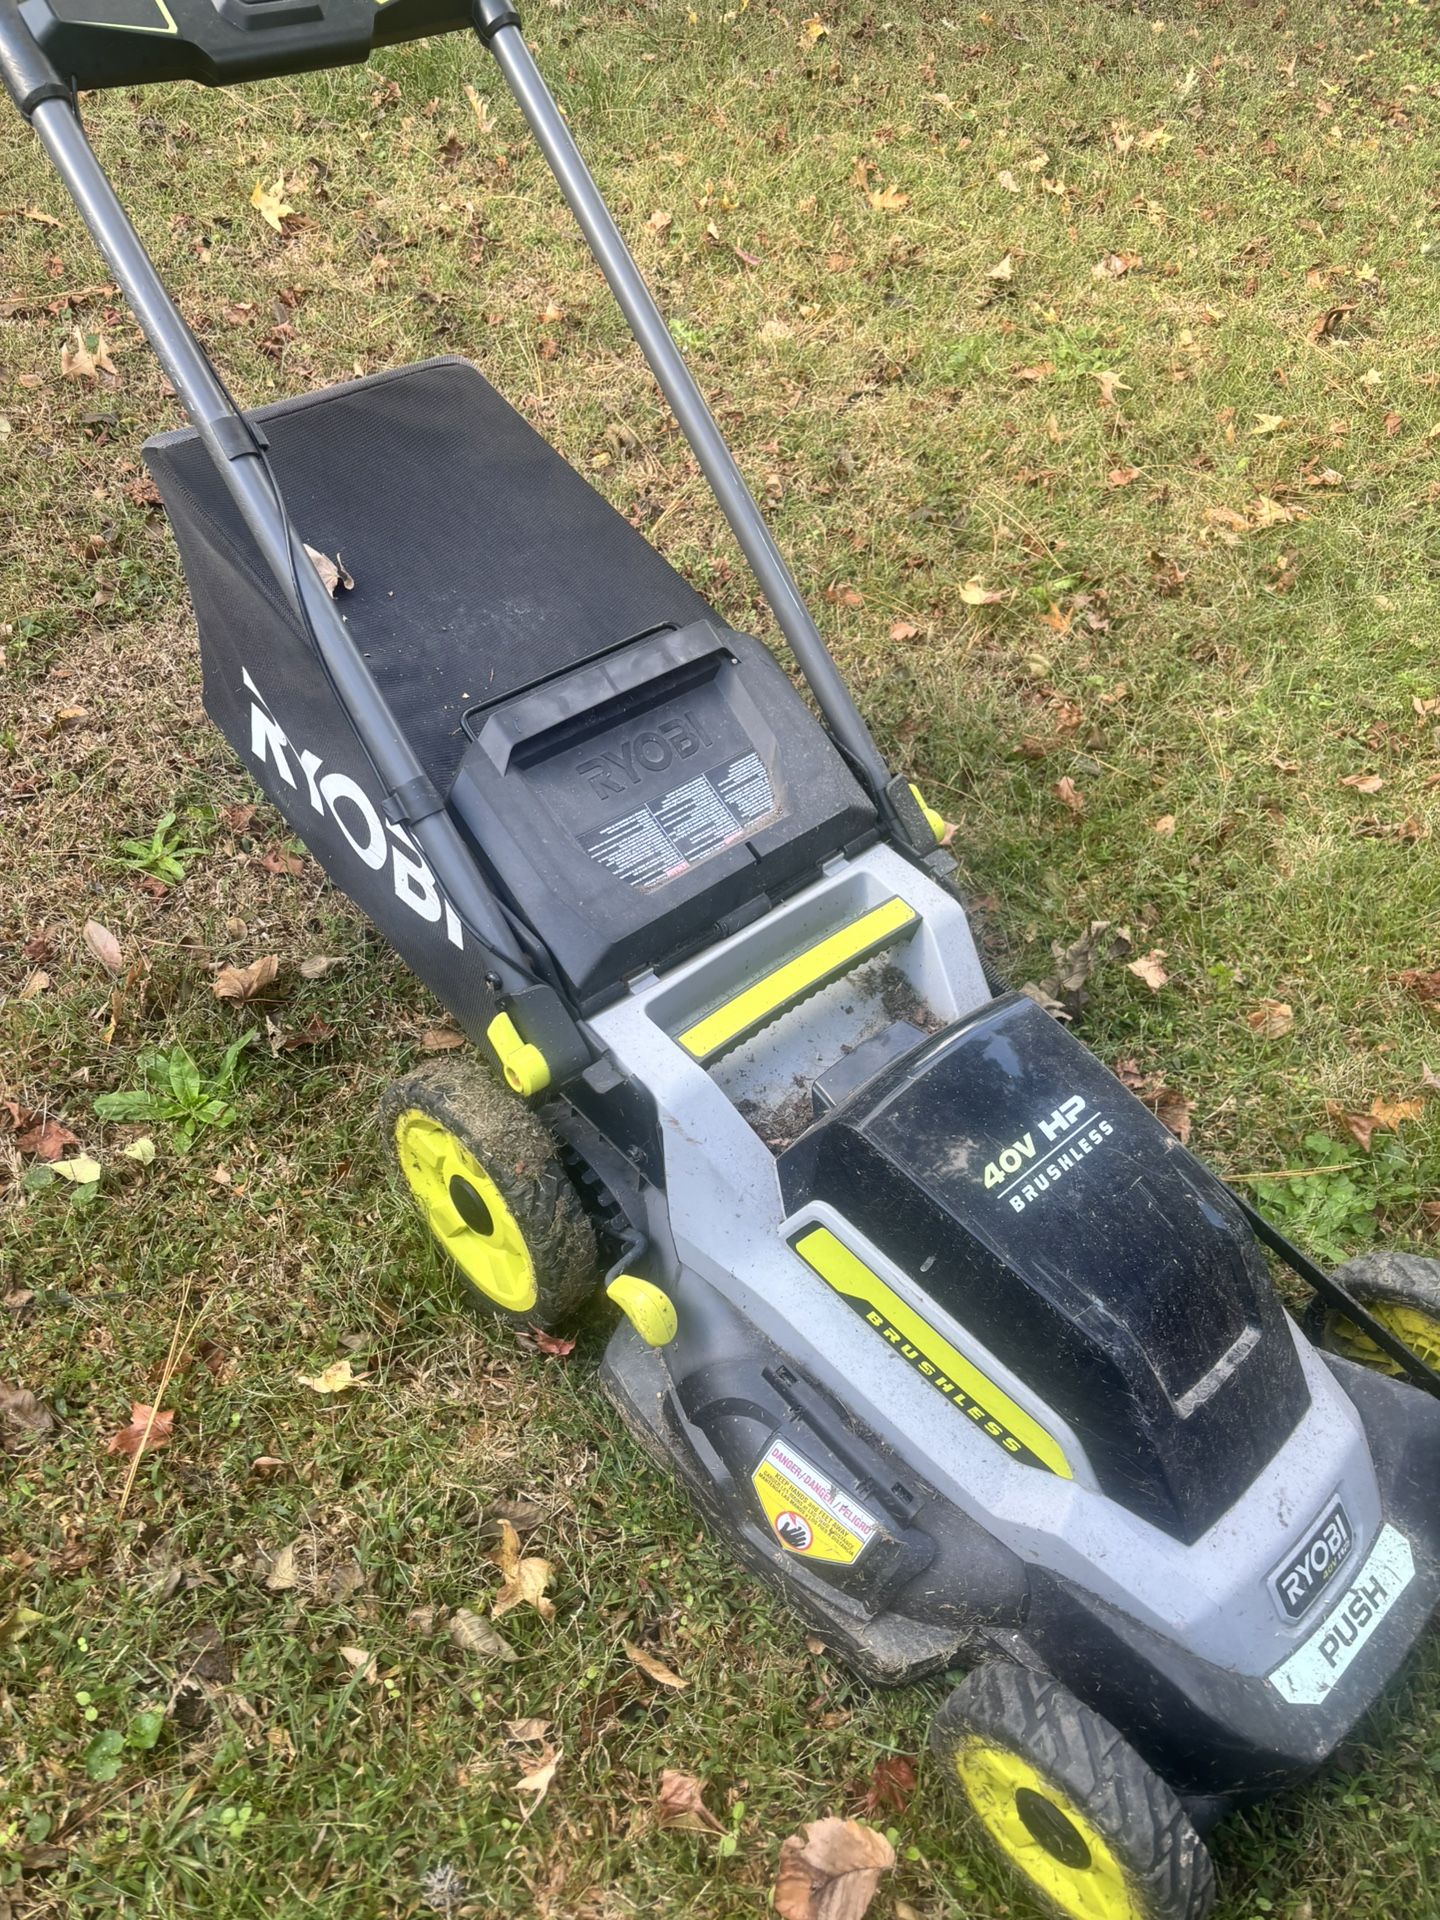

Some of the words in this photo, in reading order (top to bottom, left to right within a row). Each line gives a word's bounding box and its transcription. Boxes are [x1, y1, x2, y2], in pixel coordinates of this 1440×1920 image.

[575, 711, 713, 800] RYOBI
[242, 666, 464, 950] RYOBI
[984, 1132, 1037, 1189] 40V
[1037, 1095, 1086, 1142] HP
[1009, 1120, 1114, 1213] BRUSHLESS
[865, 1311, 1021, 1452] BRUSHLESS
[774, 1472, 789, 1486] KEEP
[788, 1484, 808, 1503] HANDS
[807, 1501, 818, 1512] and
[818, 1510, 833, 1523] FEET
[831, 1521, 848, 1537] AWAY
[838, 1504, 872, 1535] PELIGRO
[1281, 1514, 1348, 1606] RYOBI
[1322, 1556, 1337, 1580] 40V
[1318, 1575, 1388, 1668] PUSH
